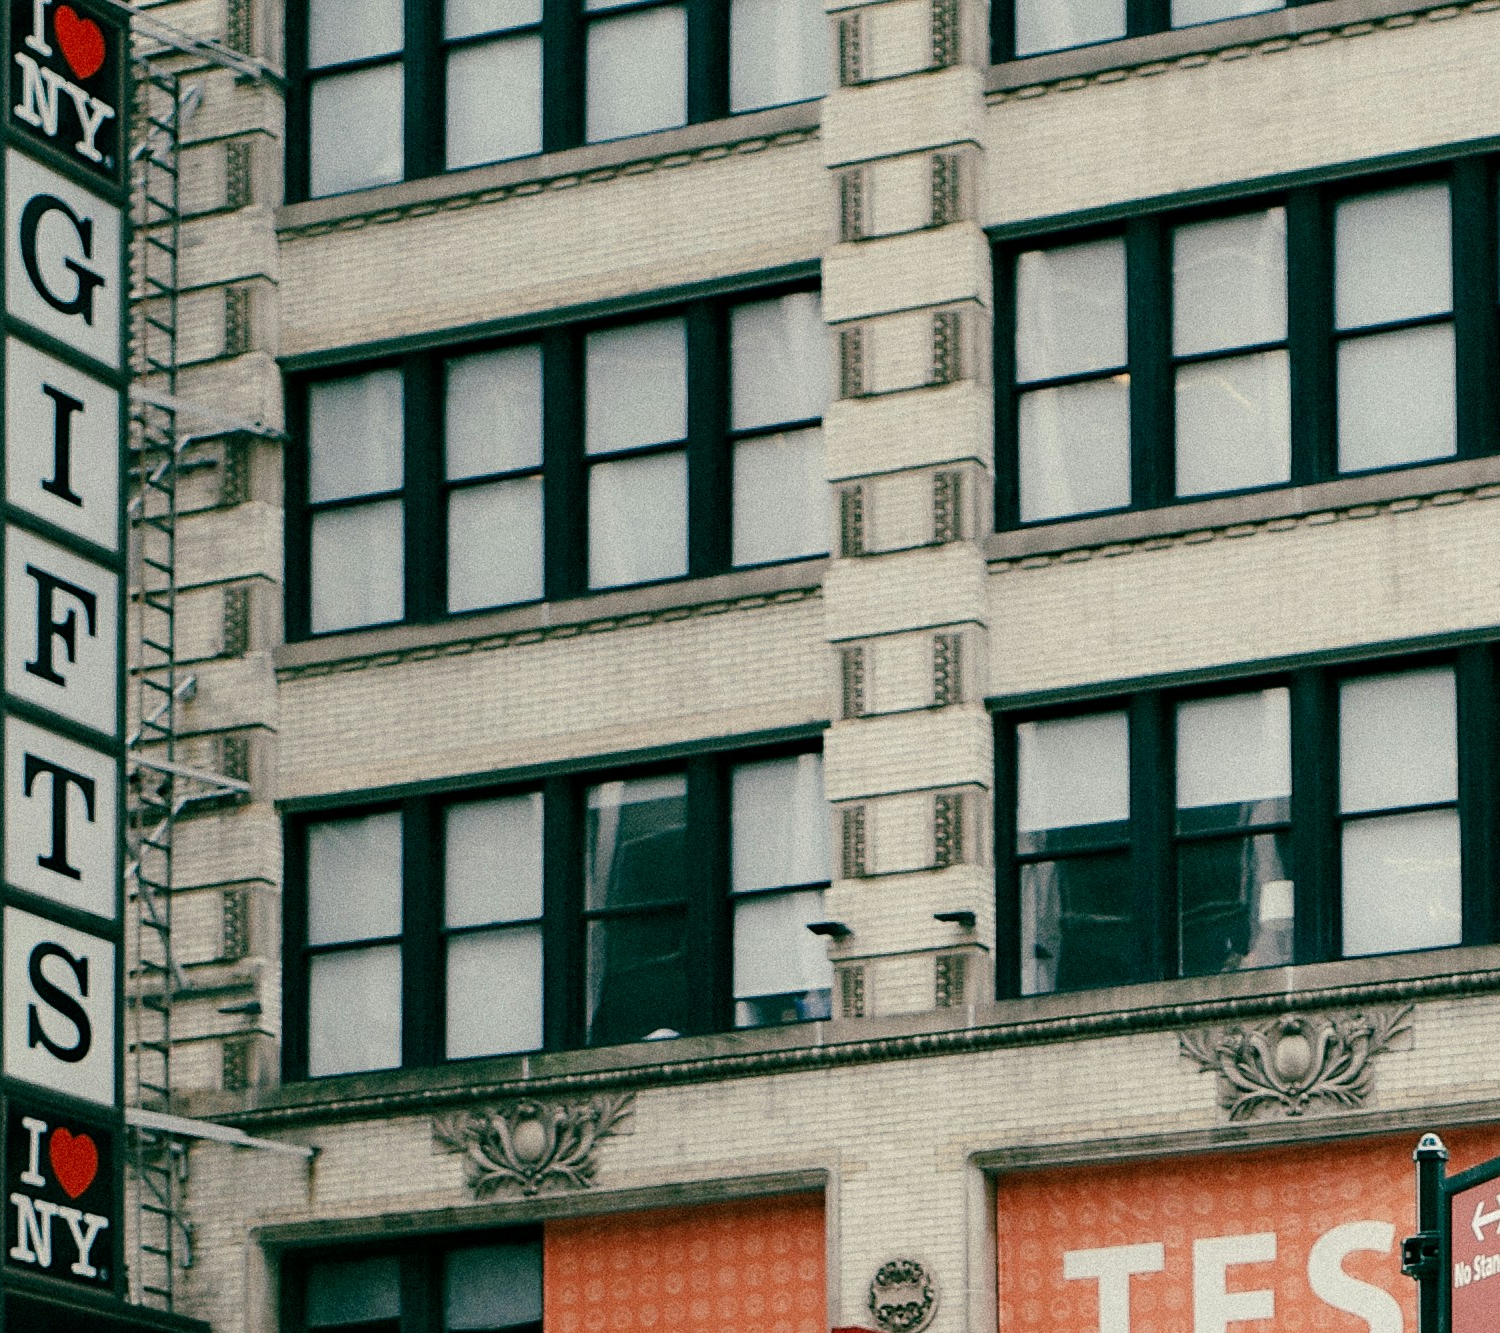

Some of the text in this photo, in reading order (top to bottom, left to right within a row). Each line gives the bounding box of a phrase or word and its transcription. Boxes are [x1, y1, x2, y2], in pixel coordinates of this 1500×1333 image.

[13, 52, 109, 162] NY
[19, 193, 105, 1063] GIFTS
[20, 1116, 47, 1187] I
[11, 1194, 108, 1278] NY
[1454, 1261, 1472, 1288] No
